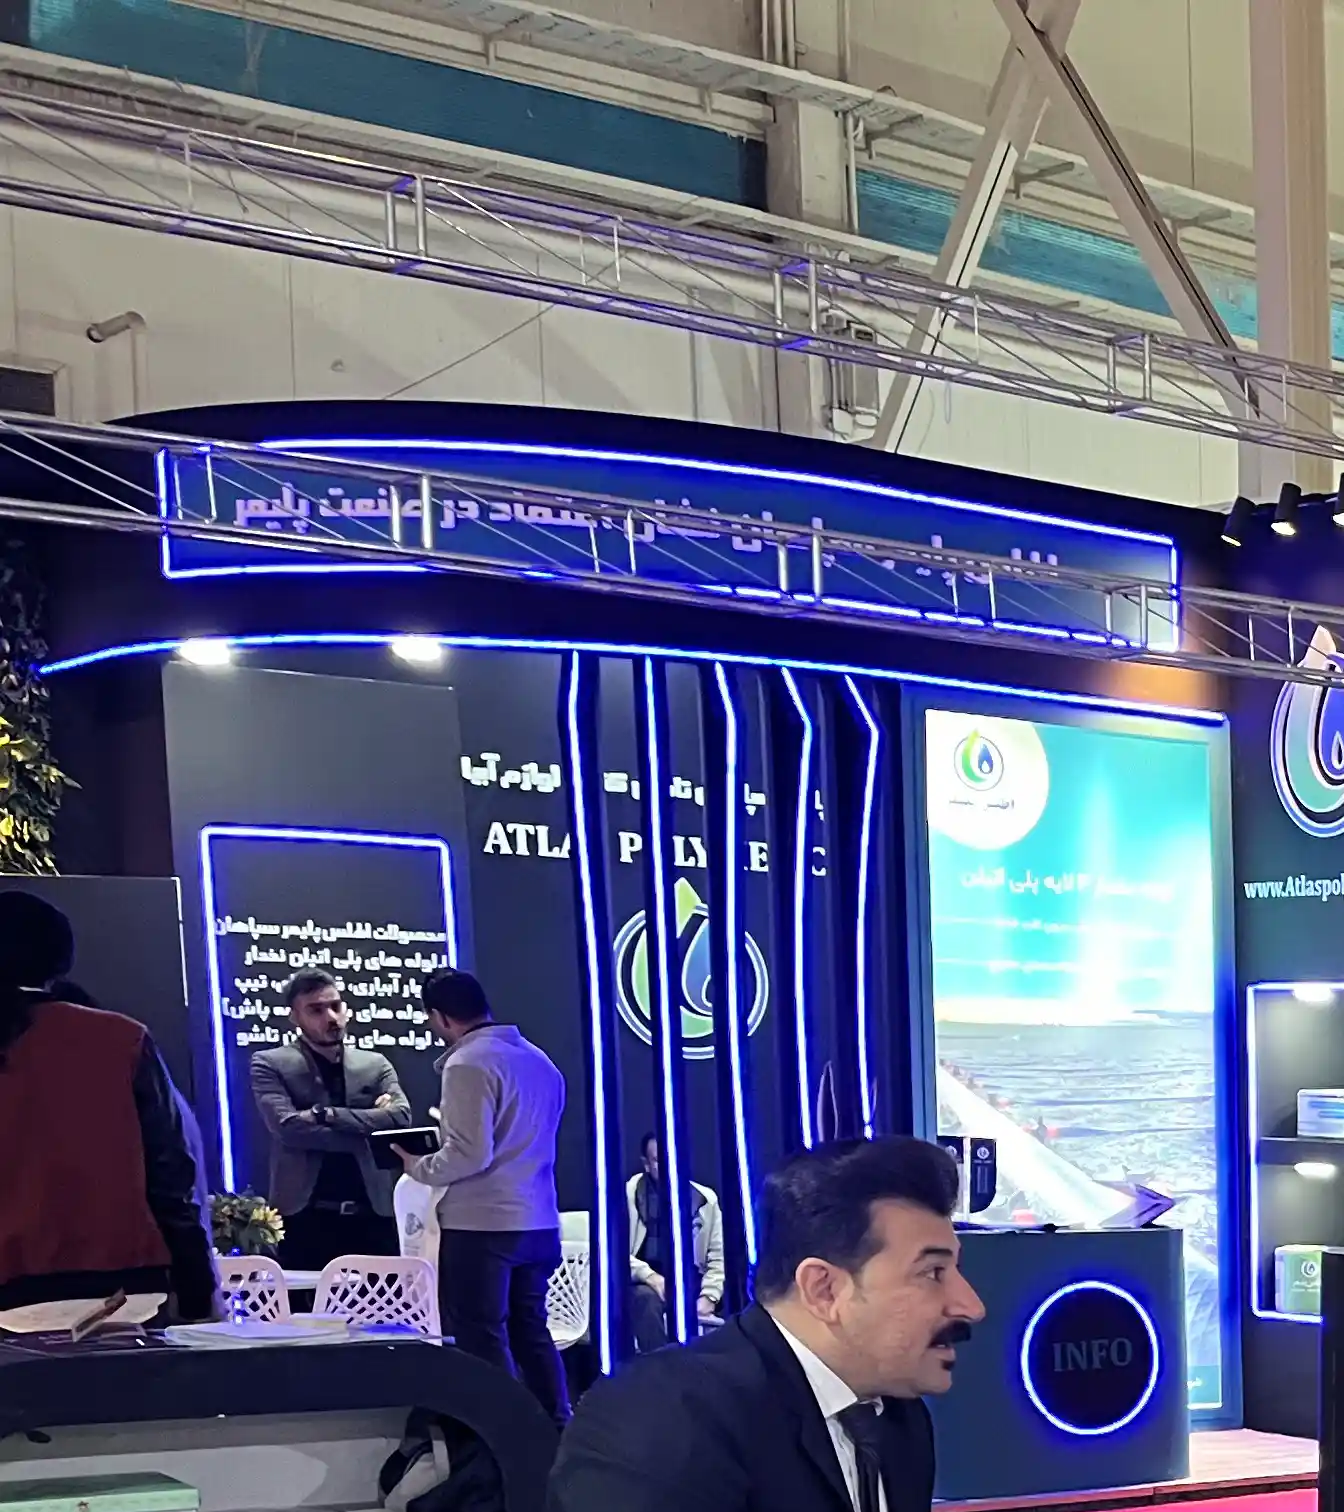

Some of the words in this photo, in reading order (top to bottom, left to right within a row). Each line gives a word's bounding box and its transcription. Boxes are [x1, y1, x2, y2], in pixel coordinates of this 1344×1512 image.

[233, 481, 311, 534] پلیمر
[440, 499, 480, 529] در
[215, 916, 281, 940] سپاهان
[281, 919, 323, 943] پلیمر
[322, 922, 372, 942] اطلس
[372, 924, 447, 944] محصولات
[289, 947, 331, 967] اتیلن
[333, 949, 363, 972] پلی
[364, 950, 402, 971] های
[234, 973, 268, 994] تیپ
[355, 1003, 394, 1023] های
[236, 1024, 280, 1047] تاشو
[358, 1029, 396, 1049] های
[398, 1030, 432, 1050] لوله
[1052, 1337, 1133, 1372] INFO
